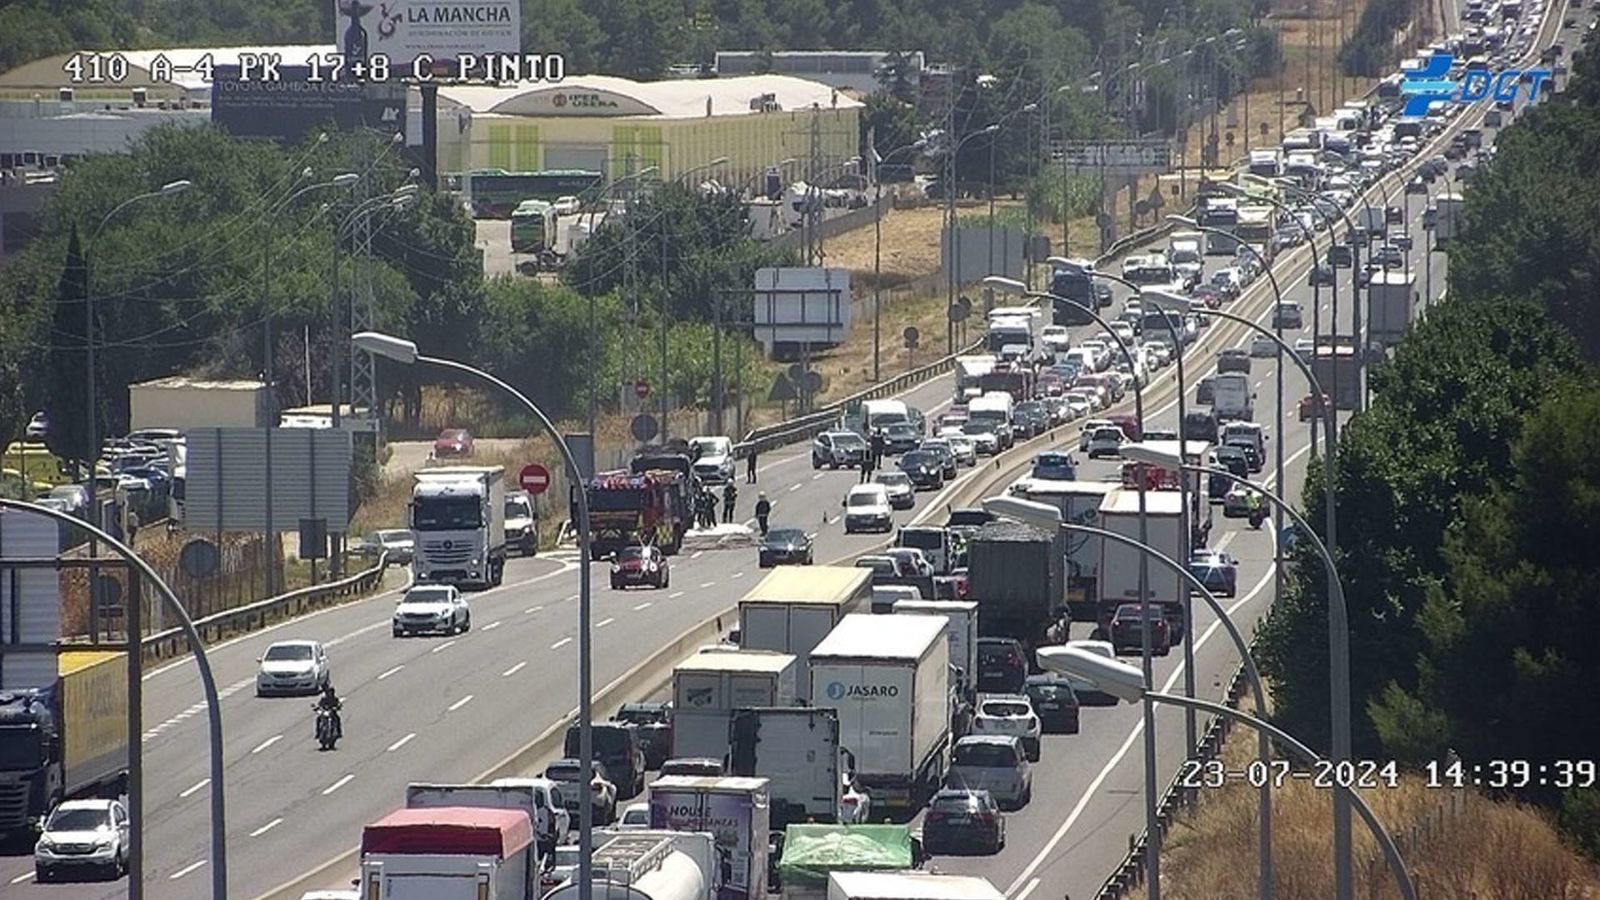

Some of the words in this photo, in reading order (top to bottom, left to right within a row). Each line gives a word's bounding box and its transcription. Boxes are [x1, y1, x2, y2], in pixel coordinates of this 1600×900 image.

[408, 8, 429, 22] LA
[434, 7, 510, 22] MANCHA
[847, 685, 898, 697] JASARO
[670, 806, 712, 818] HOUSE
